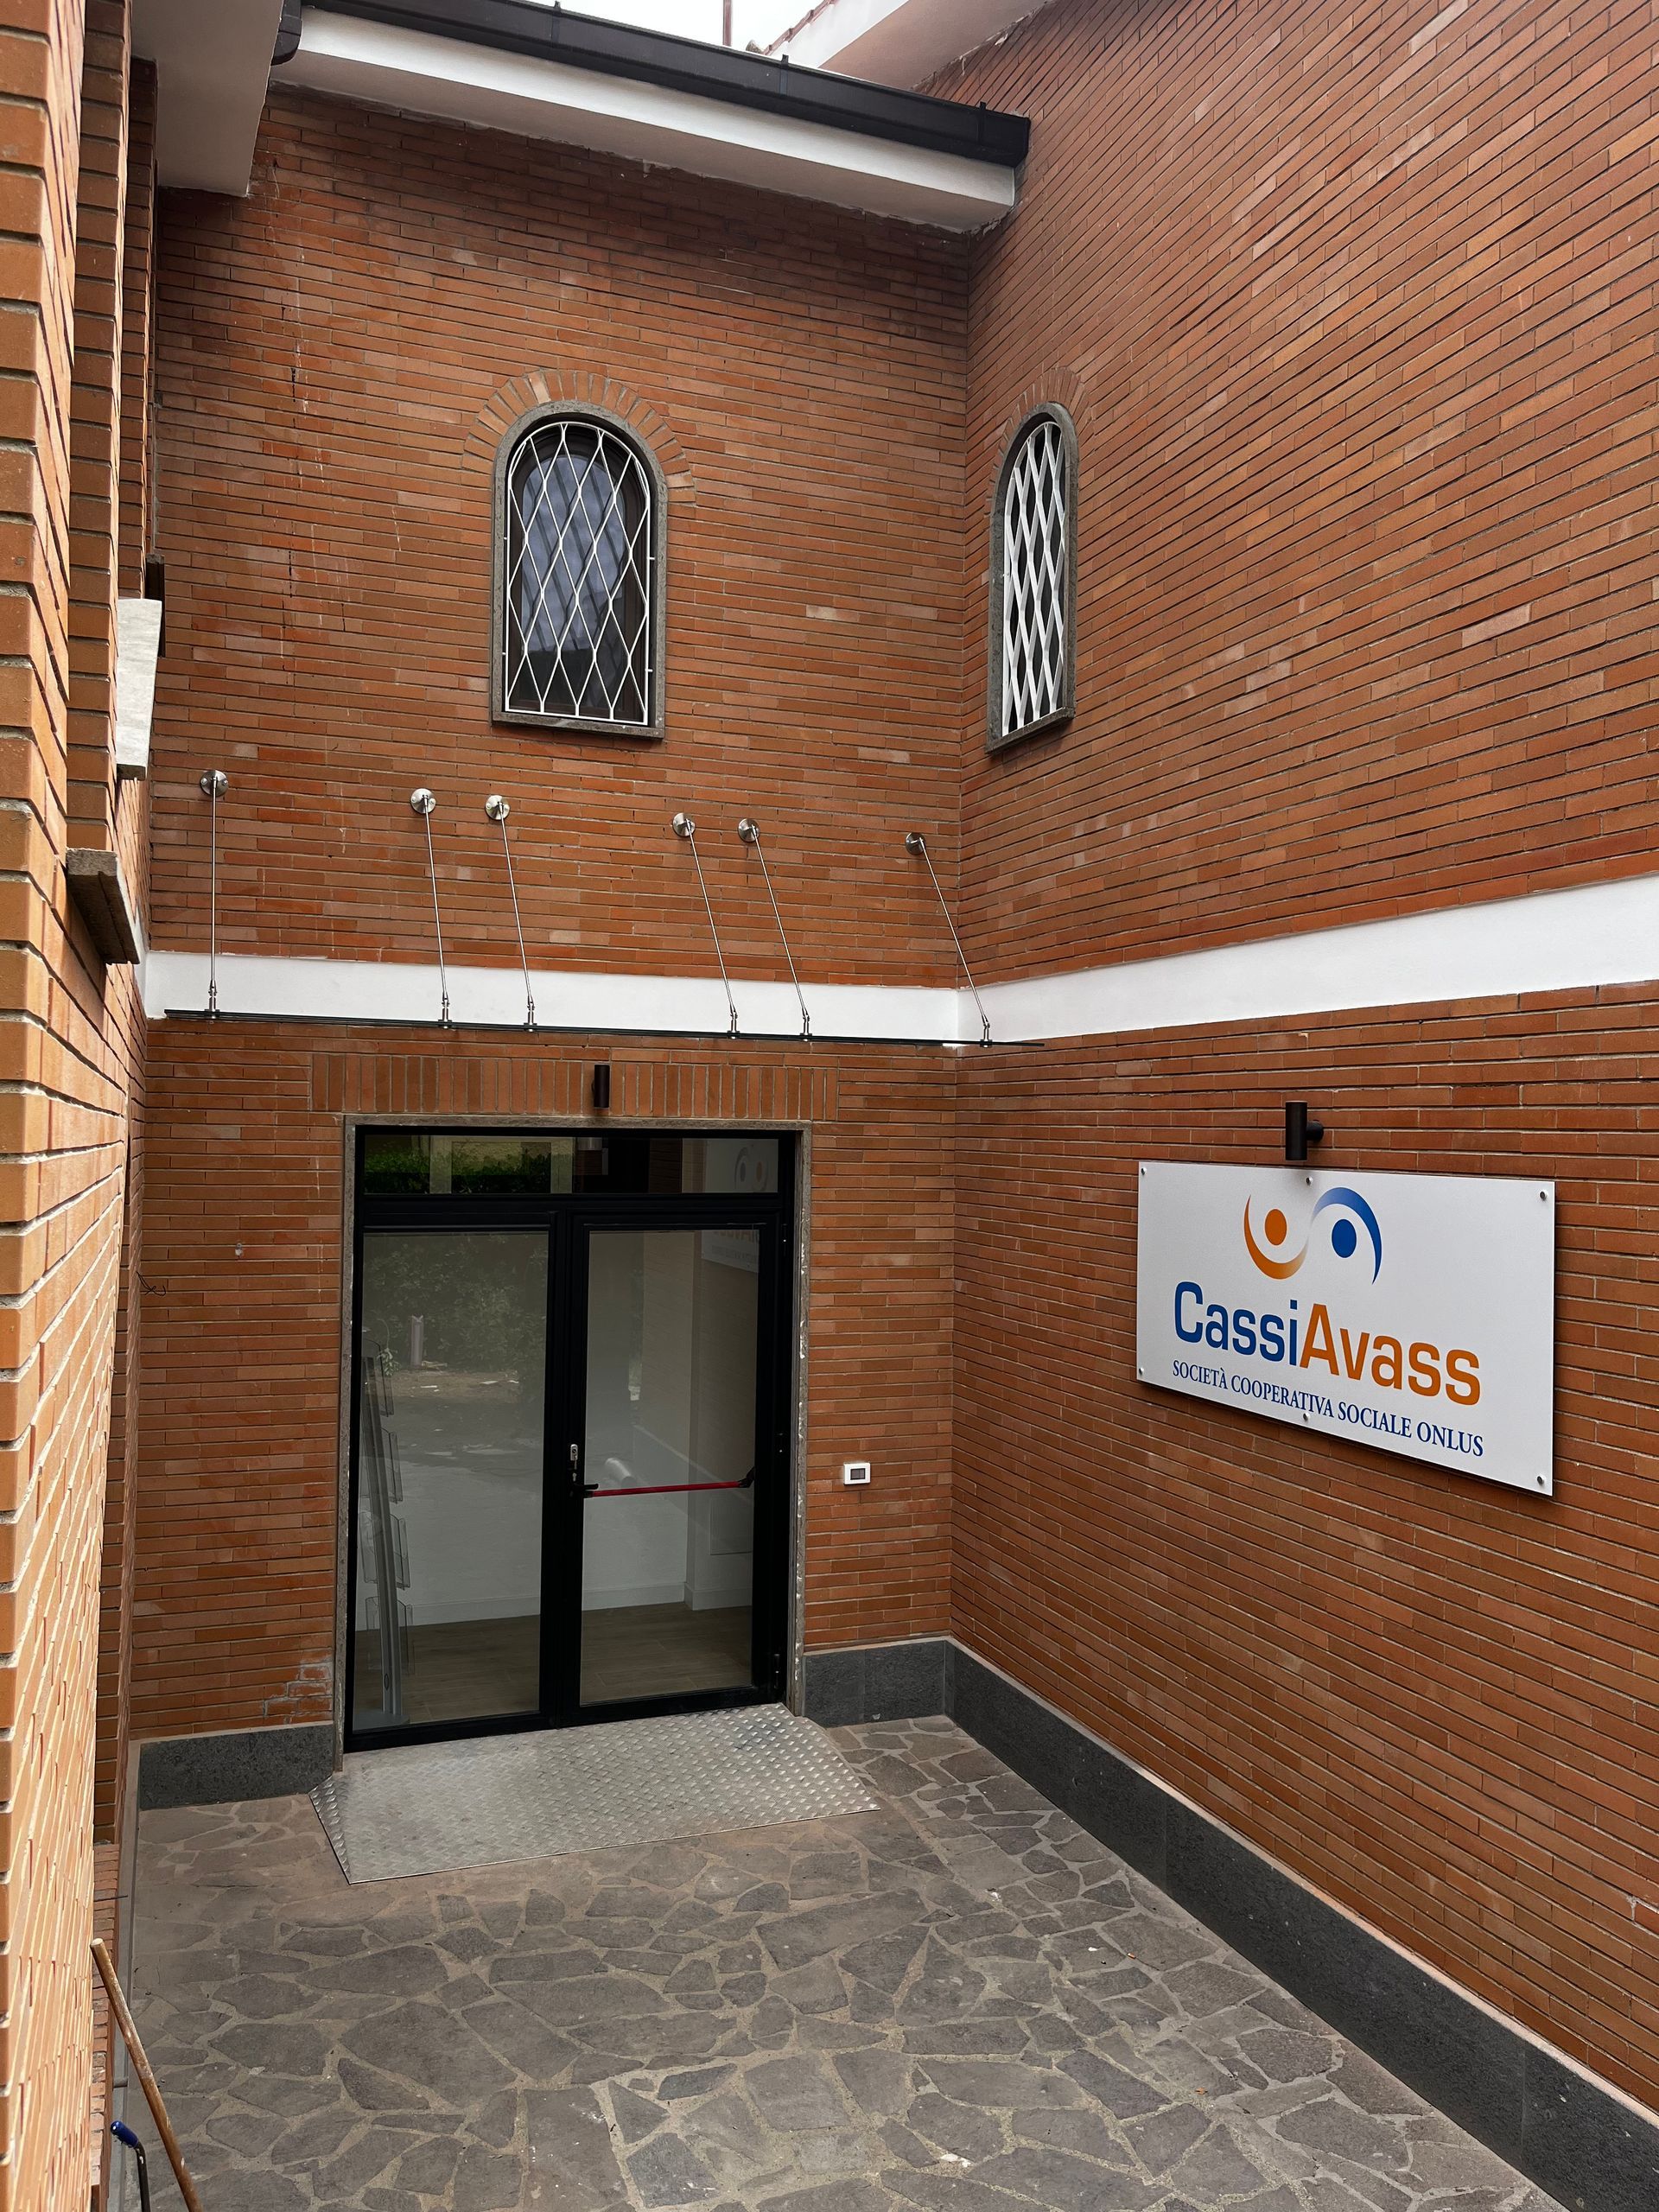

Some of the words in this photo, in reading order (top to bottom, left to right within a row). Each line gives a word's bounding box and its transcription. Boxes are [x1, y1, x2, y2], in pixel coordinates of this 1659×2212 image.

[1175, 1281, 1480, 1405] CassiAvass
[1173, 1359, 1228, 1389] SOCIETÀ
[1231, 1375, 1333, 1417] COOPERATIVA
[1338, 1402, 1411, 1438] SOCIALE
[1416, 1422, 1483, 1456] ONLUS
